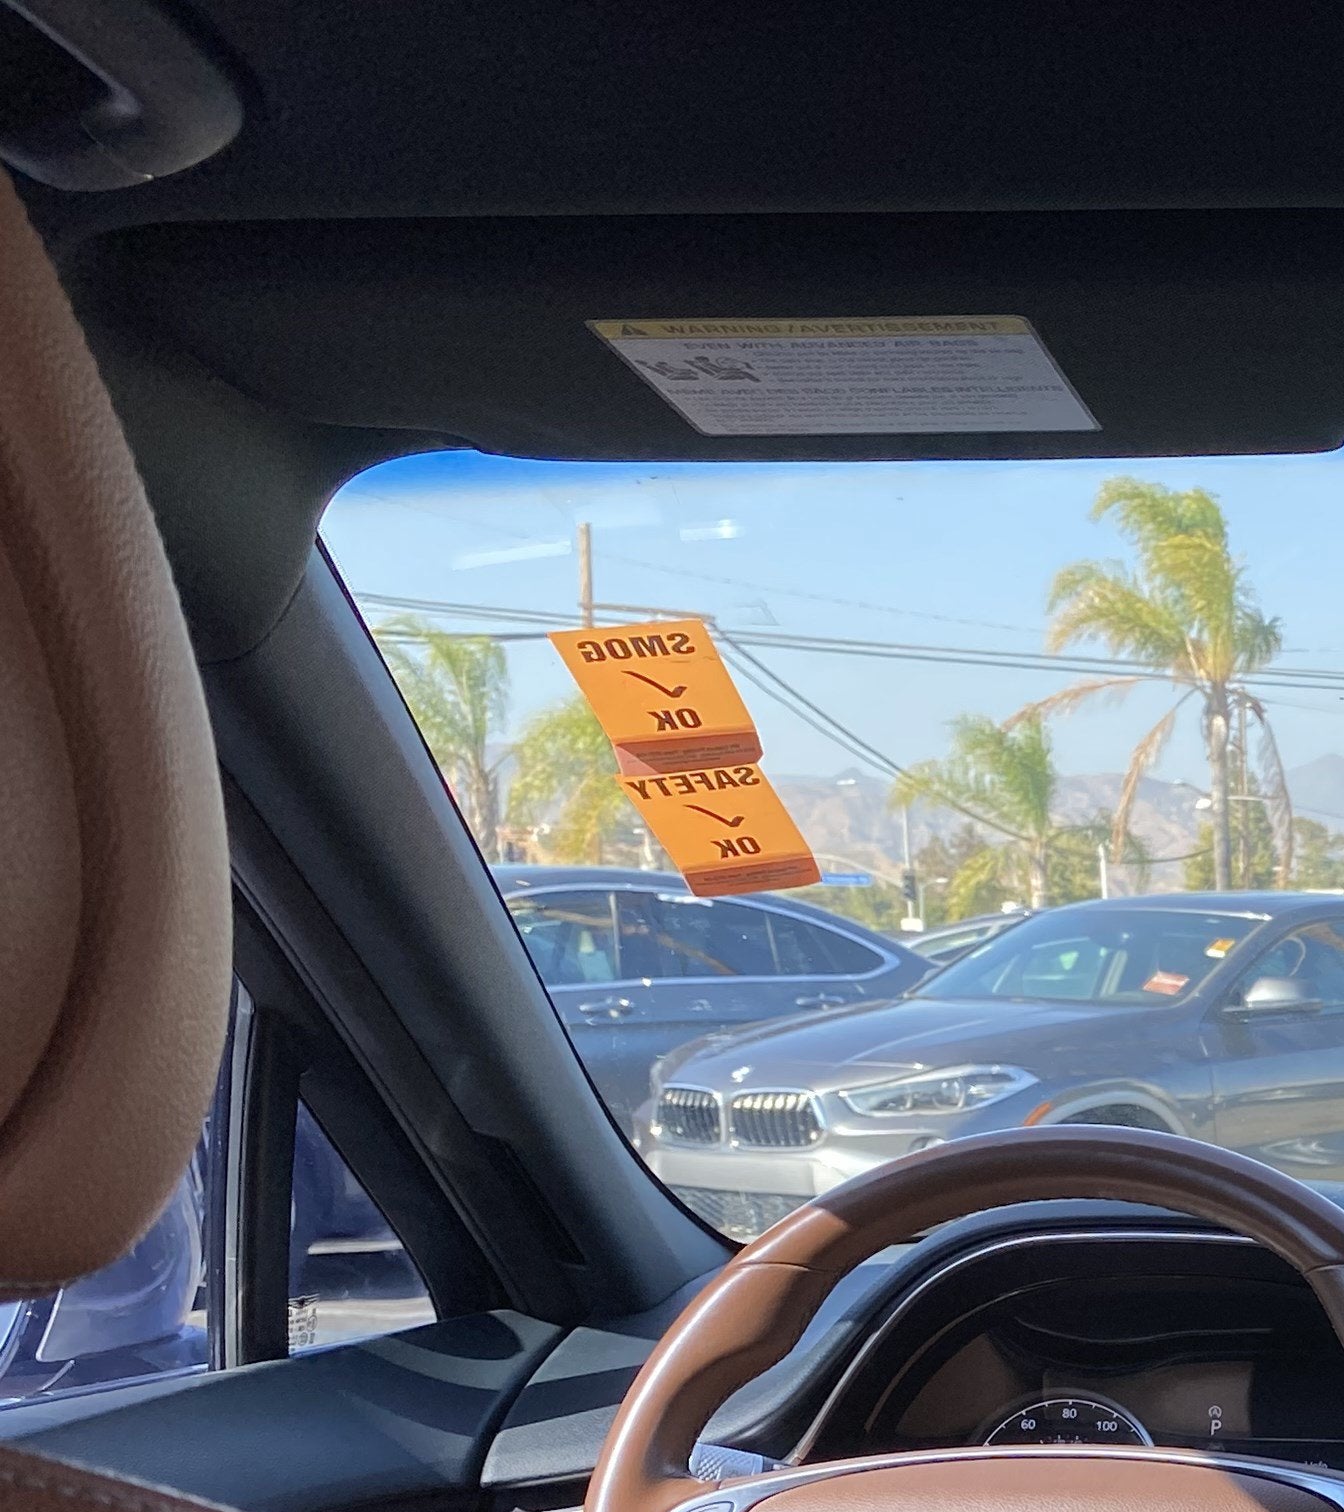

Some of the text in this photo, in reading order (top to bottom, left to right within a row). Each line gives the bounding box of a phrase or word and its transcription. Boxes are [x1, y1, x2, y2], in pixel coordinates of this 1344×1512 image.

[660, 323, 780, 335] WARNING
[800, 320, 999, 334] AVERTISSEMENT
[1062, 1408, 1077, 1419] 80
[1020, 1418, 1036, 1430] 60
[1096, 1420, 1118, 1432] 100
[1210, 1420, 1222, 1435] P
